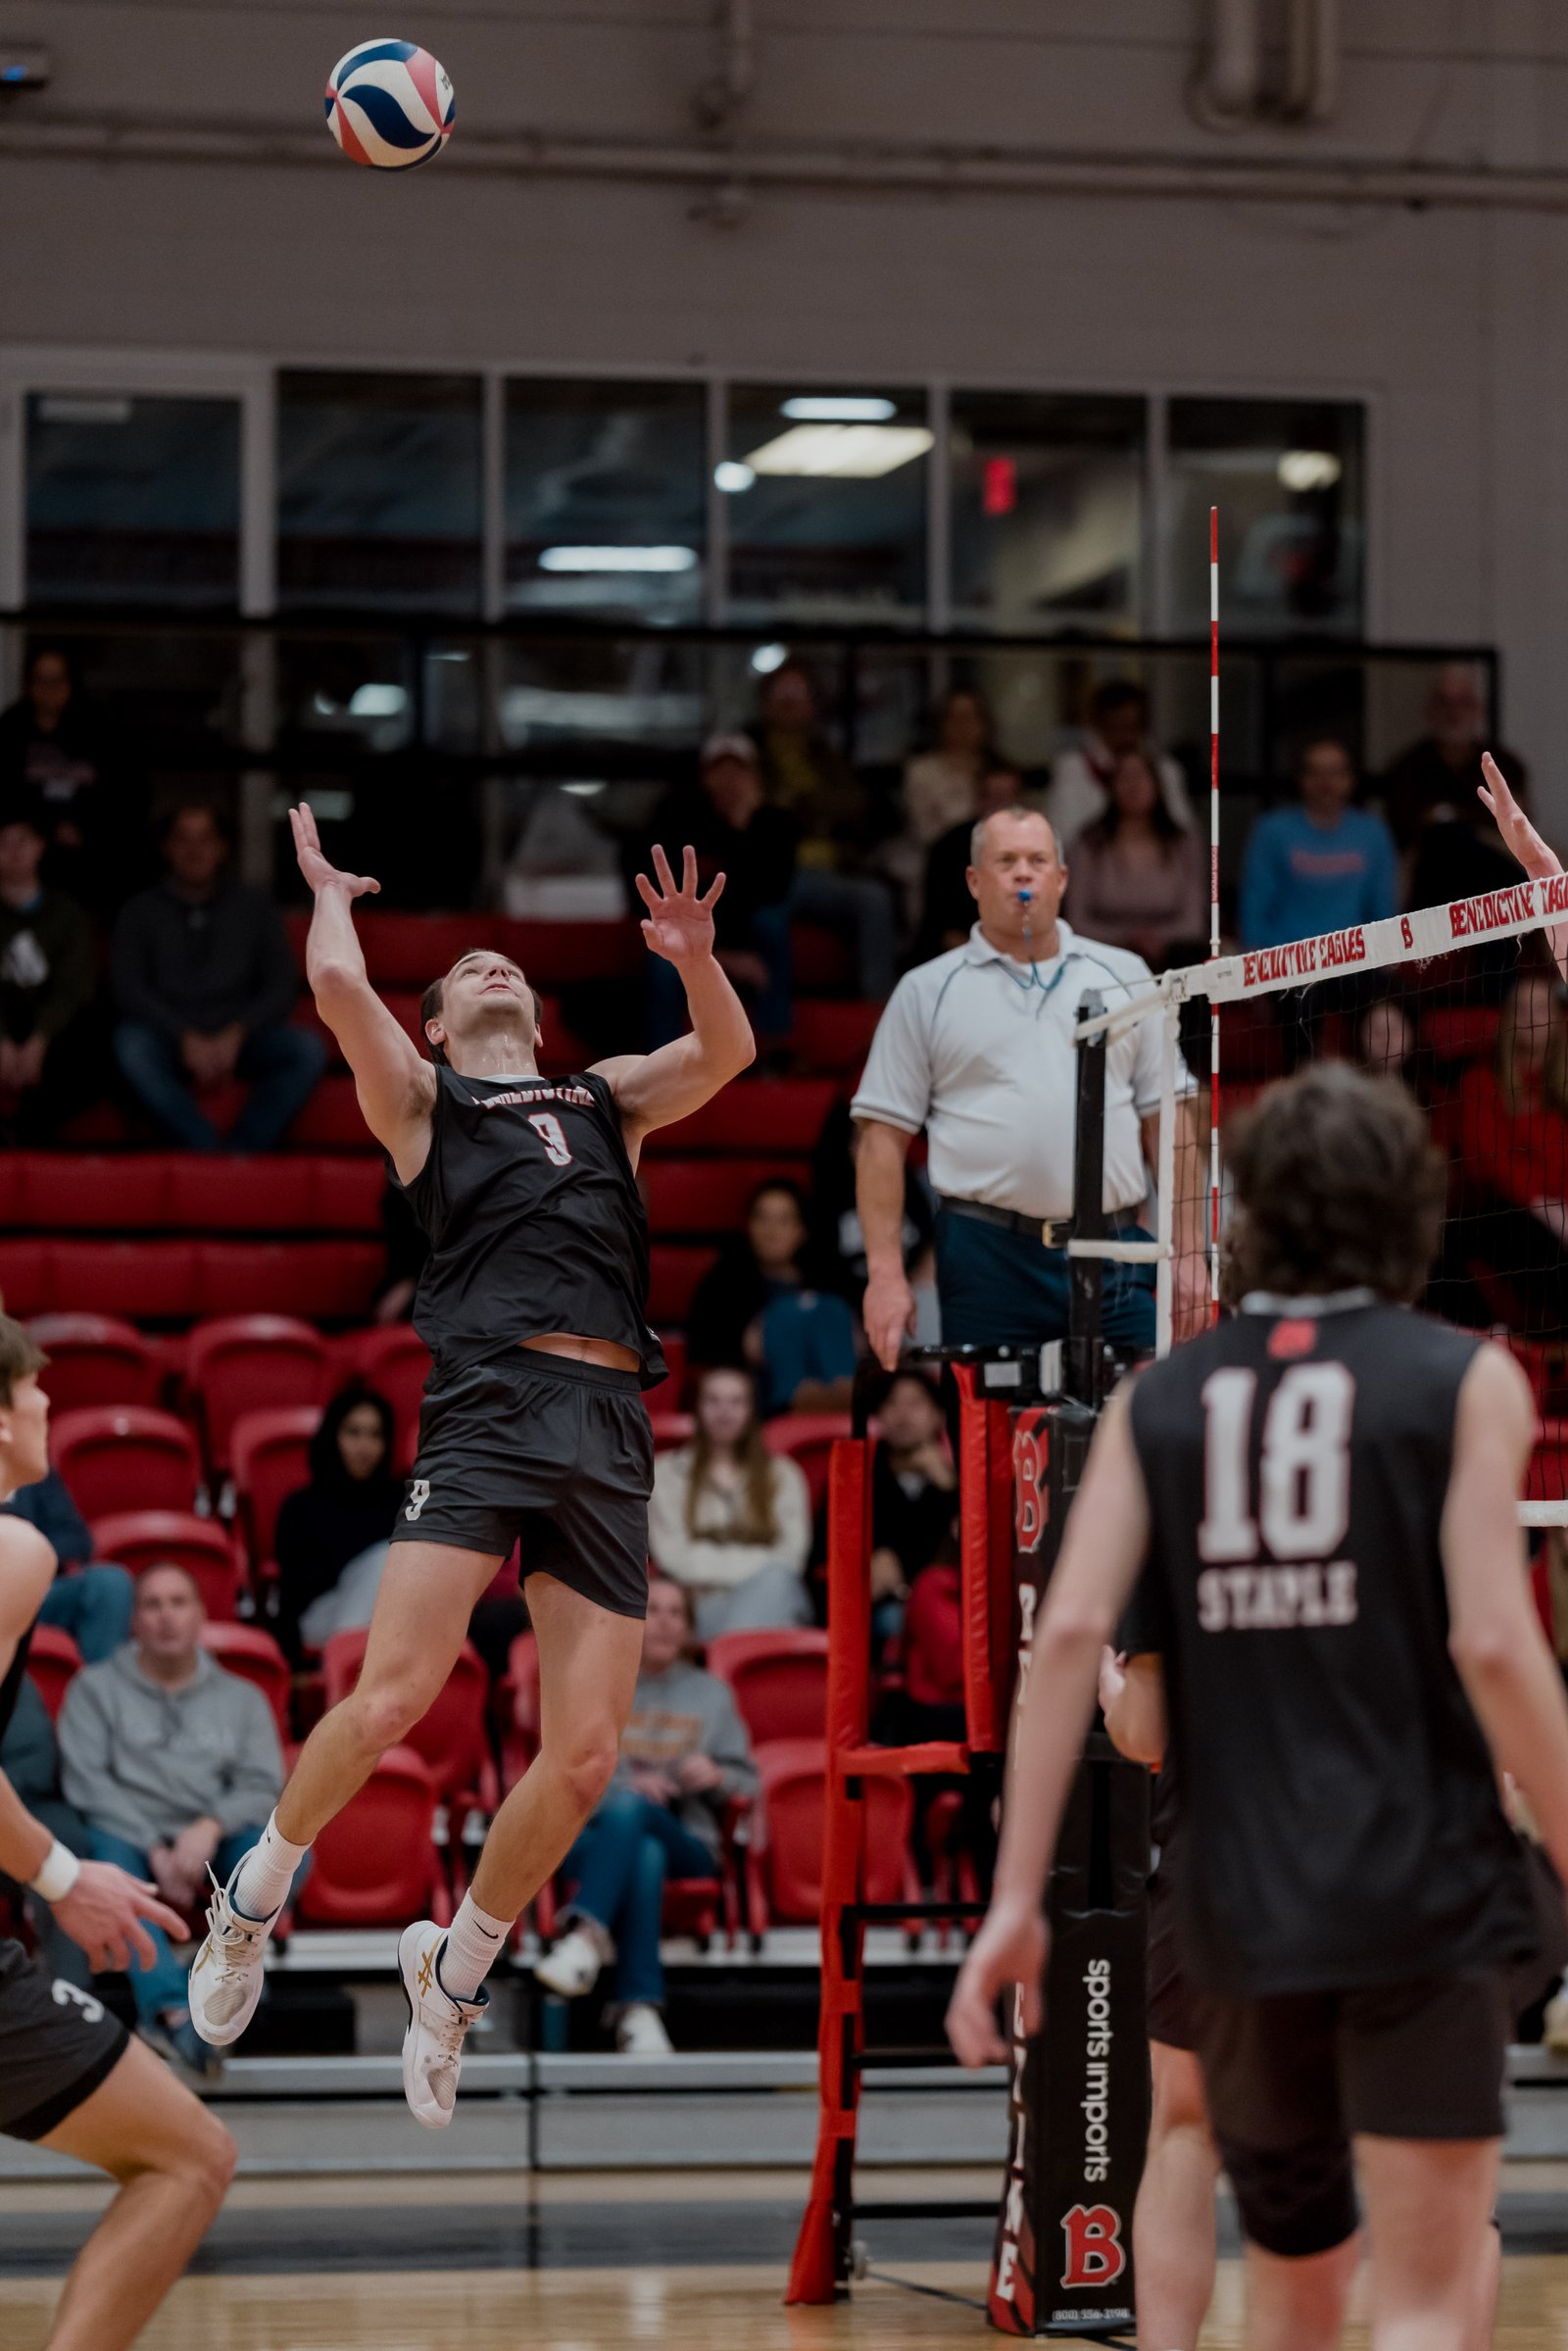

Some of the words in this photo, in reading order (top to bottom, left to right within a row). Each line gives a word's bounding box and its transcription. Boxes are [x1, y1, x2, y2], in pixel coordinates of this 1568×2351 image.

[1400, 915, 1413, 950] B
[527, 1112, 572, 1166] 9
[1198, 1360, 1356, 1563] 18
[405, 1479, 430, 1521] 9
[1197, 1560, 1358, 1632] STAPLE
[51, 1978, 105, 2023] 3
[1082, 1959, 1111, 2057] sports
[1080, 2062, 1111, 2182] imports
[1059, 2203, 1126, 2289] B
